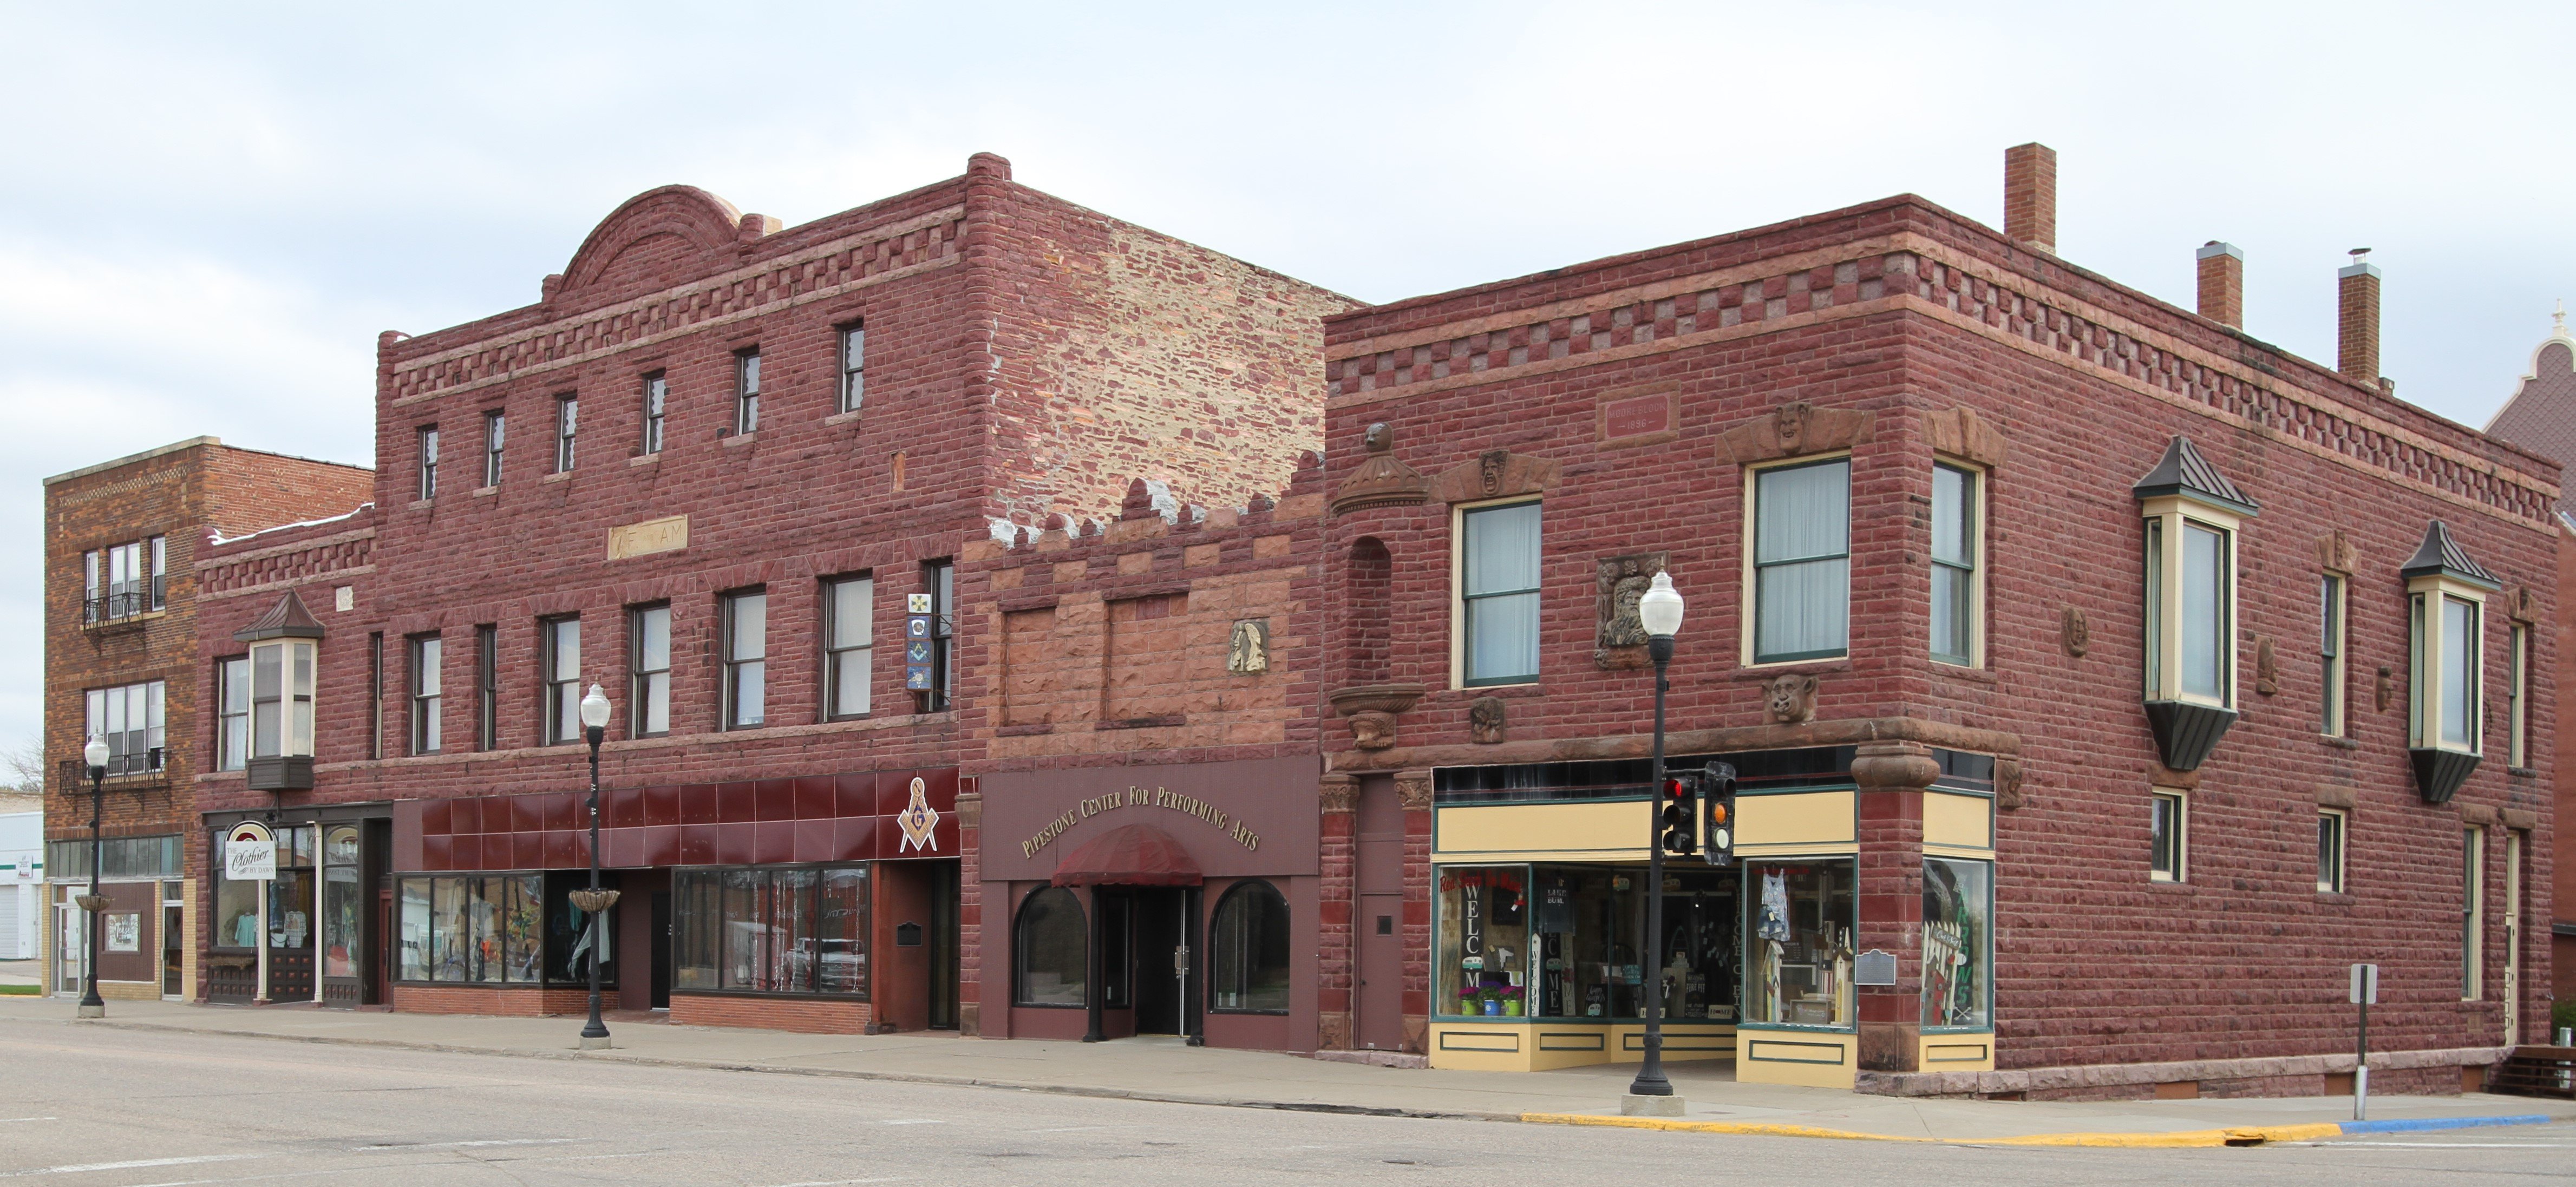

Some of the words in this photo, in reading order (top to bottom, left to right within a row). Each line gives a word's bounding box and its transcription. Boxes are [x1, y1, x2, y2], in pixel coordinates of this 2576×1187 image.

[1609, 408, 1636, 418] MOORE
[1638, 402, 1666, 414] BLOCK
[914, 810, 923, 827] G
[232, 846, 269, 871] Clothier
